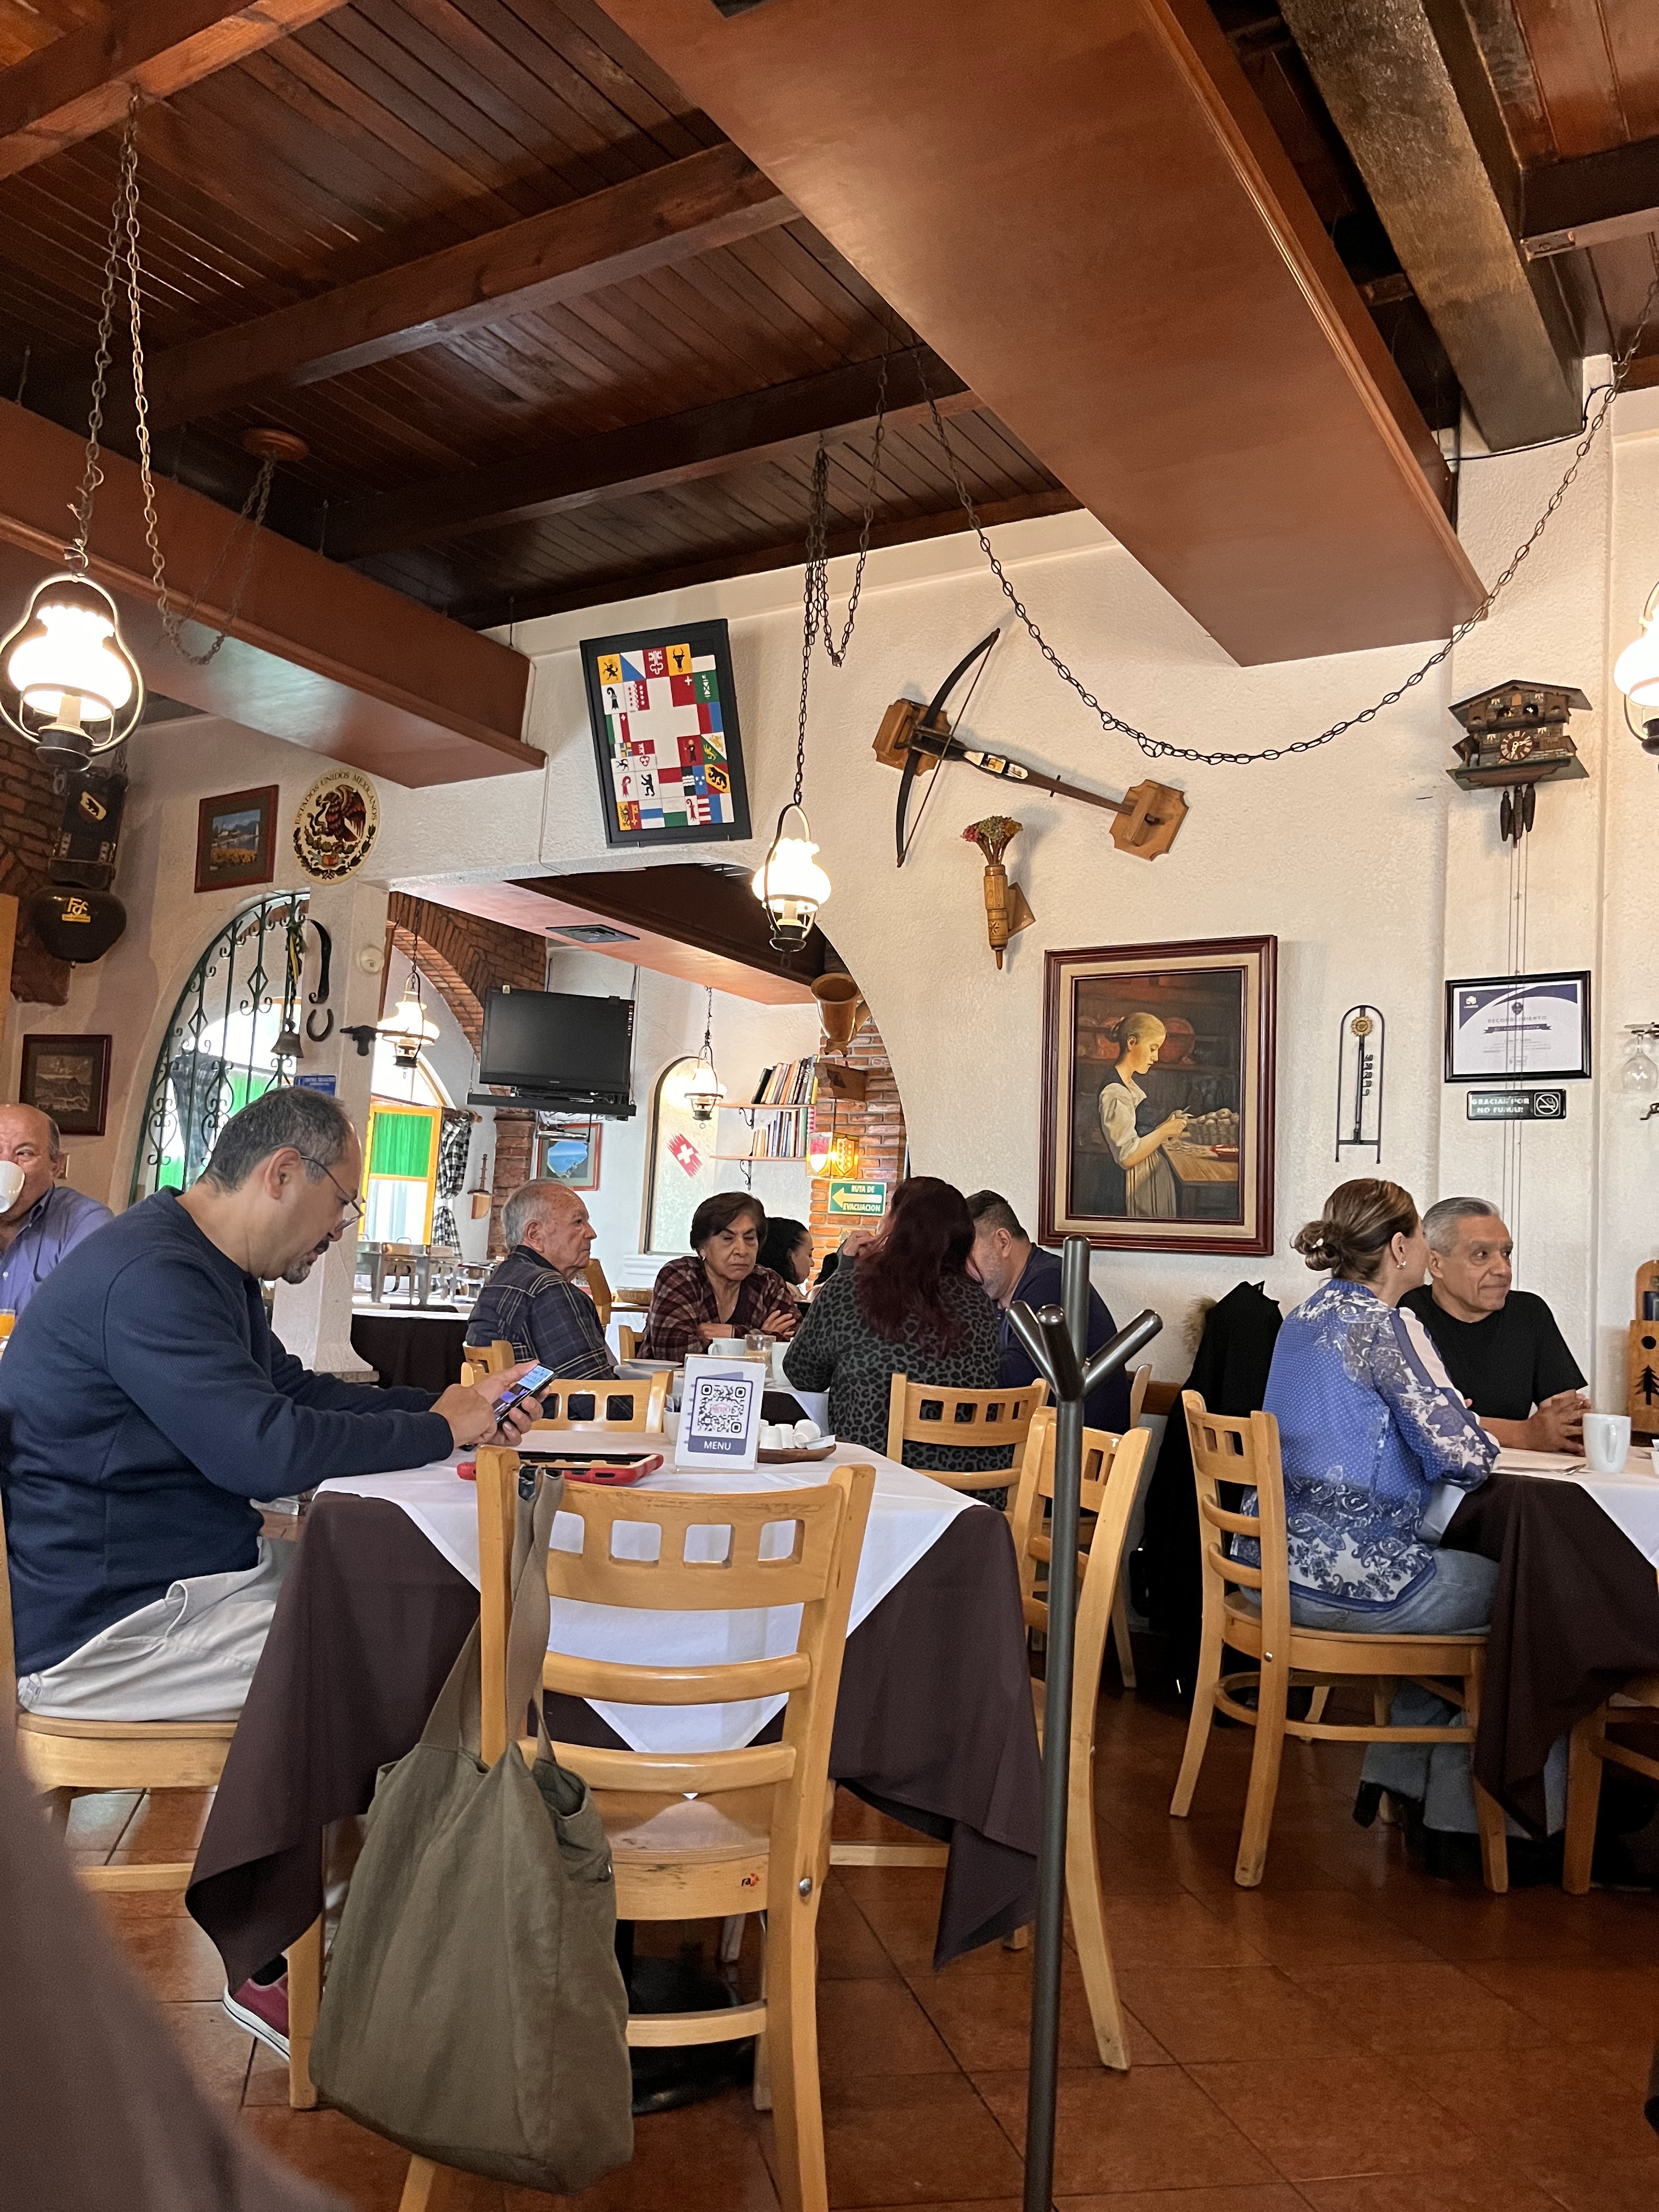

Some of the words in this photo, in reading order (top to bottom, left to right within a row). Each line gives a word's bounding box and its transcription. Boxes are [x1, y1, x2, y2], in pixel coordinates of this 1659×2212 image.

[295, 784, 319, 825] ESTADOS
[320, 771, 350, 786] UNIDOS
[352, 774, 378, 821] MEXICANOS
[851, 1184, 866, 1193] RUTA
[703, 1441, 731, 1451] MENU
